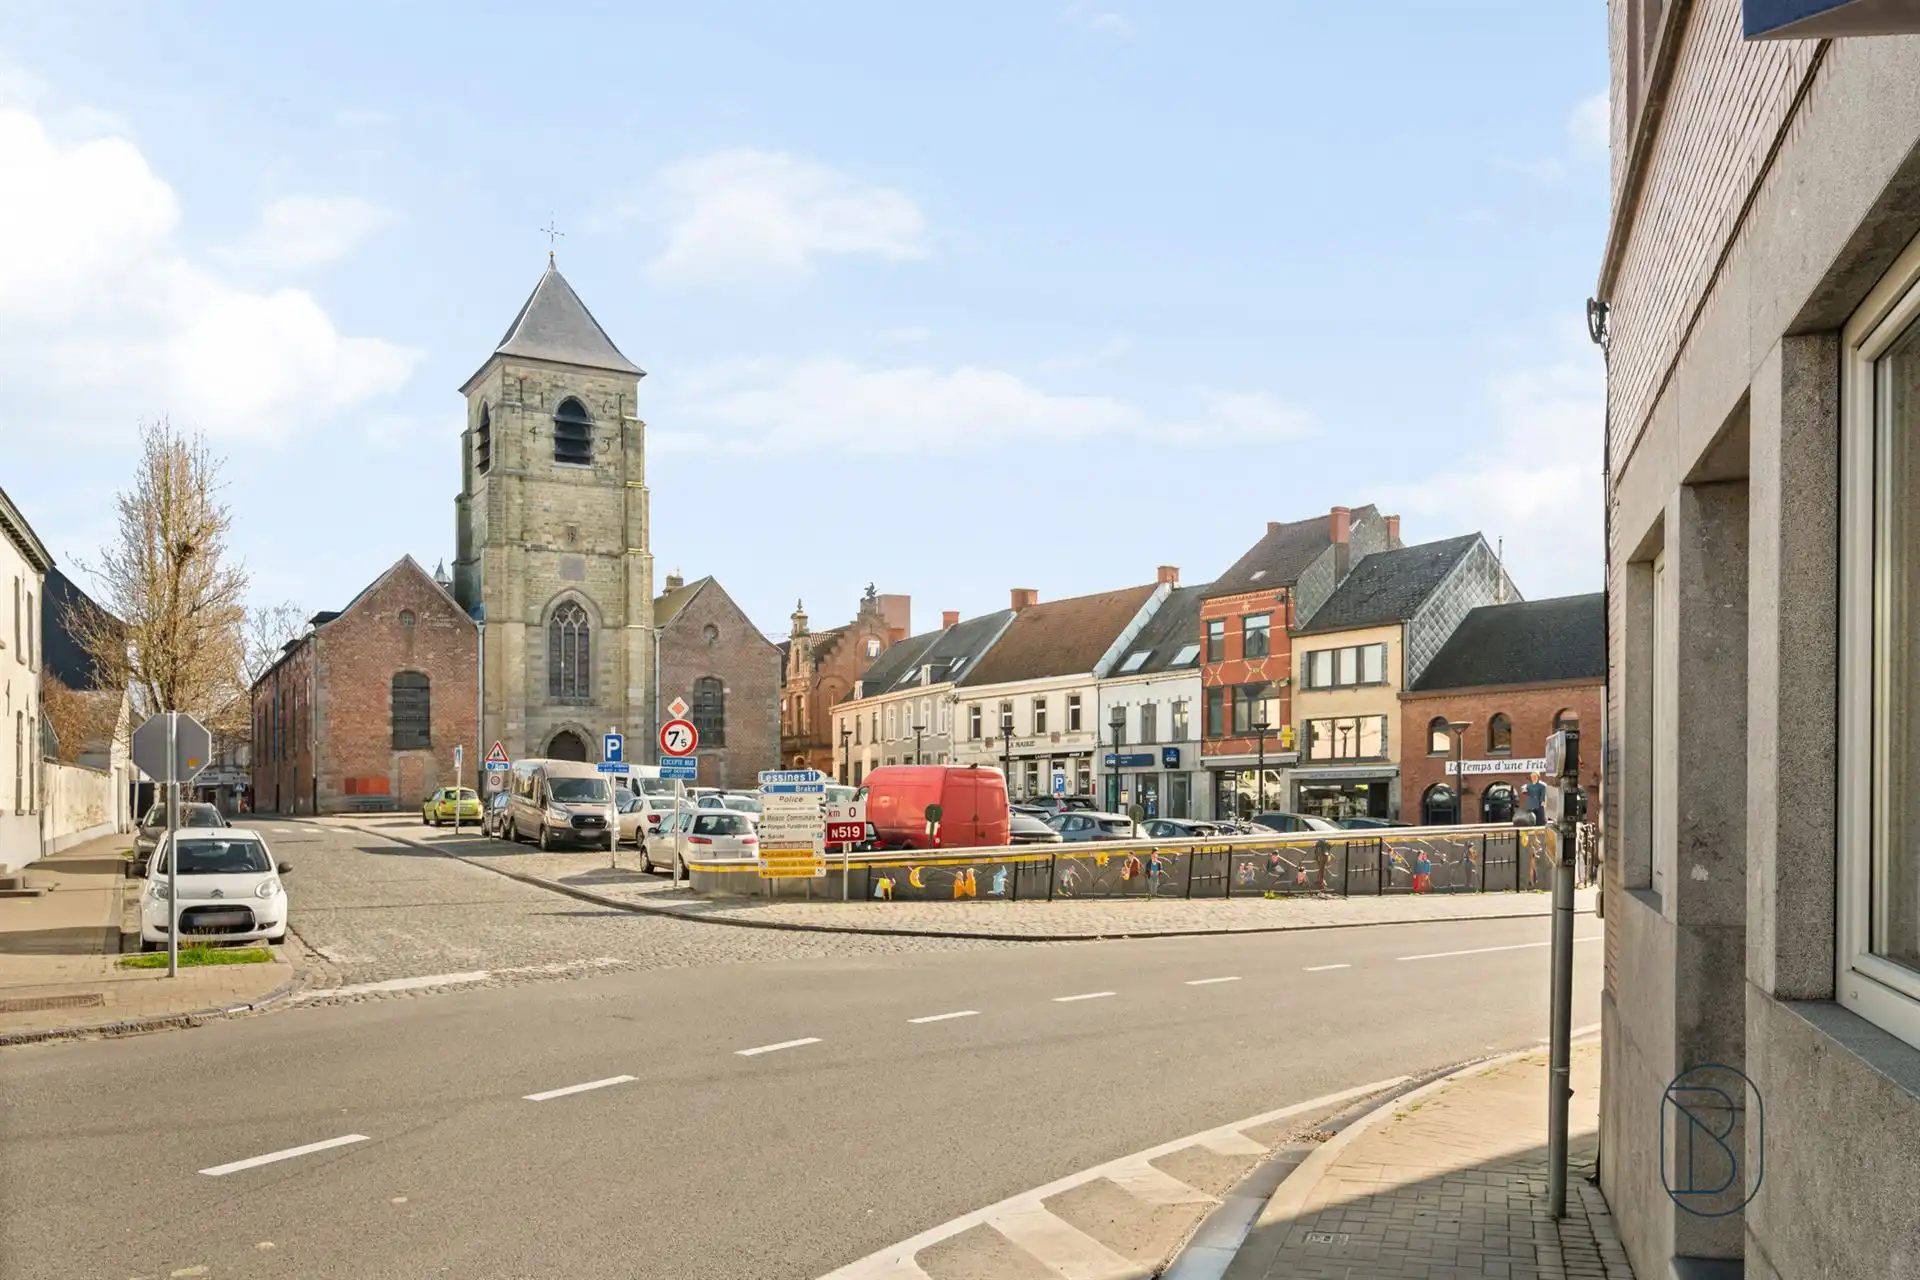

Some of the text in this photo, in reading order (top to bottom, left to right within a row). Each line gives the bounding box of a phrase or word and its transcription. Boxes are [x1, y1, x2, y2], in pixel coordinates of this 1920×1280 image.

[606, 738, 620, 758] P
[1461, 761, 1492, 773] Temps
[1494, 760, 1523, 771] d'une
[760, 771, 816, 782] Lessines 11
[795, 784, 818, 793] Brakel
[1055, 777, 1063, 789] P
[779, 795, 803, 803] Police
[828, 806, 856, 818] km 0
[831, 825, 861, 839] N519
